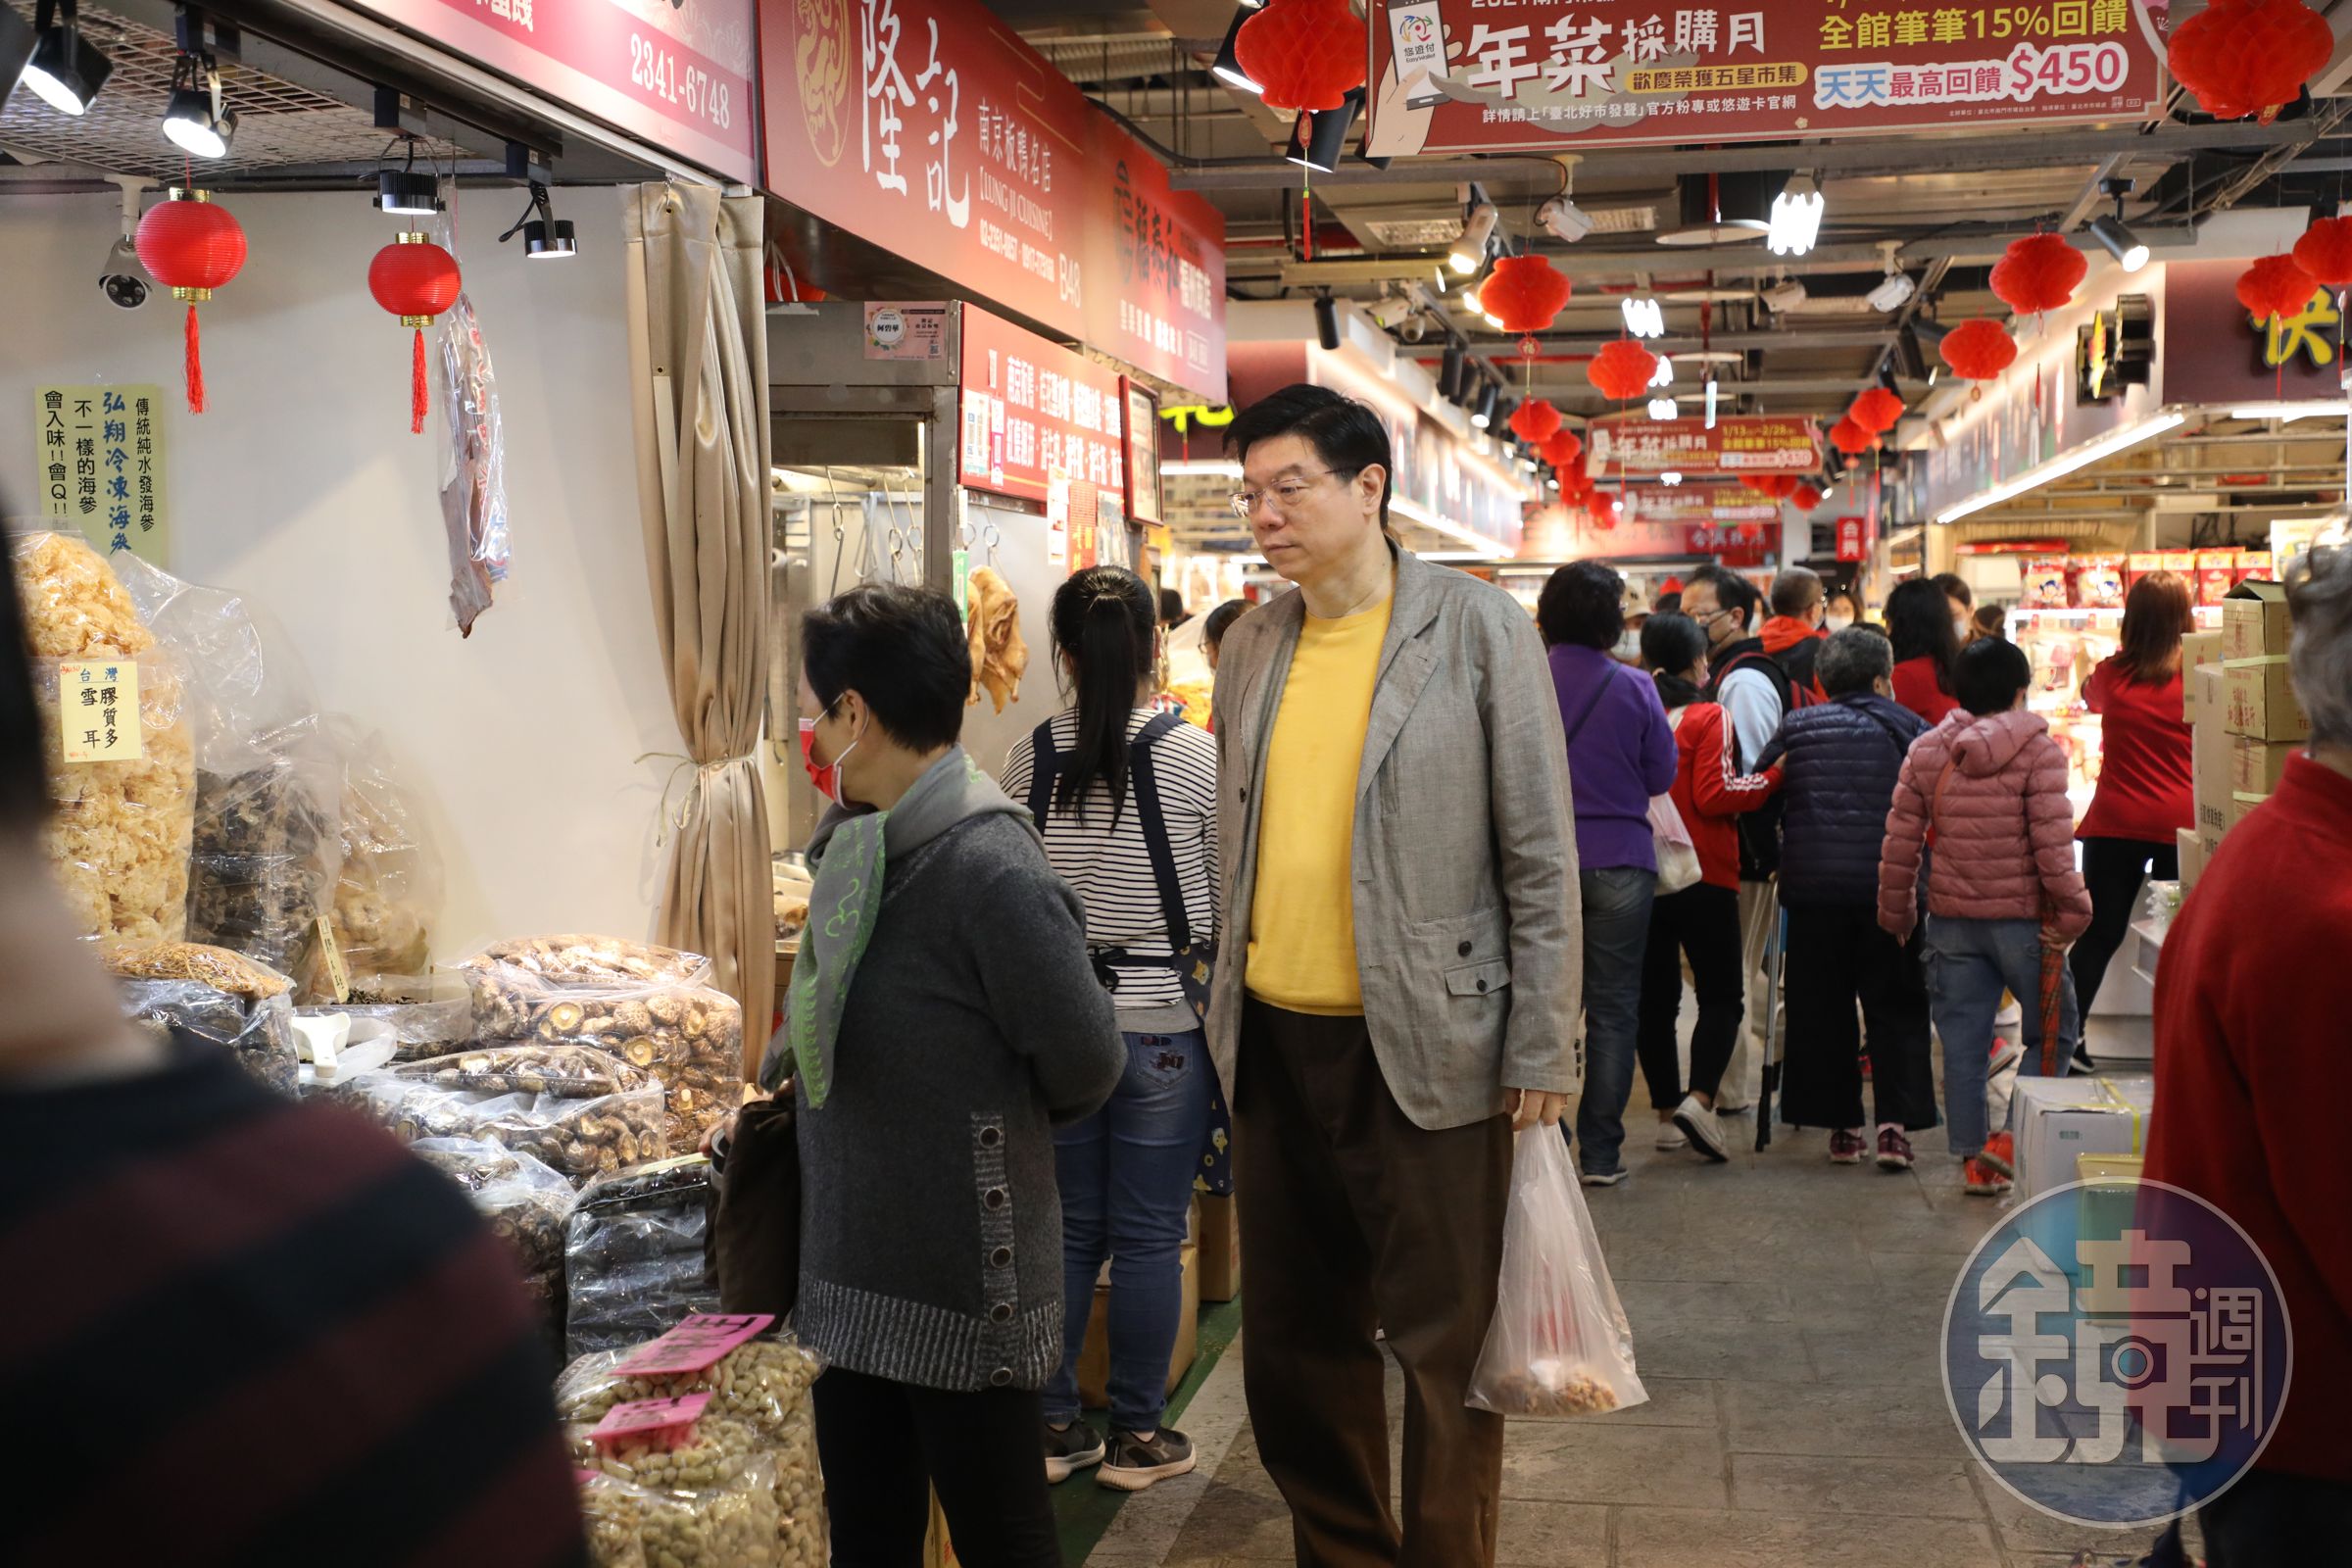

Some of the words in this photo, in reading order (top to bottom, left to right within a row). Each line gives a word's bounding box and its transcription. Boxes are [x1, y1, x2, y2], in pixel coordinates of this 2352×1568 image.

[1404, 43, 1435, 57] 悠遊付
[1466, 11, 1765, 98] 年菜採購月
[1819, 0, 2129, 51] 全館筆筆15%回饋
[631, 33, 730, 129] 2341-6748
[1633, 66, 1797, 90] 歡慶榮獲五星市集
[1820, 68, 2001, 103] 天天最高回饋
[2010, 48, 2122, 96] $450
[861, 0, 970, 229] 隆記
[1058, 252, 1082, 310] B48
[74, 400, 97, 514] 不一樣的海參
[135, 398, 155, 532] 傳統純水發海參
[79, 667, 119, 682] 台灣
[100, 686, 119, 749] 膠質多
